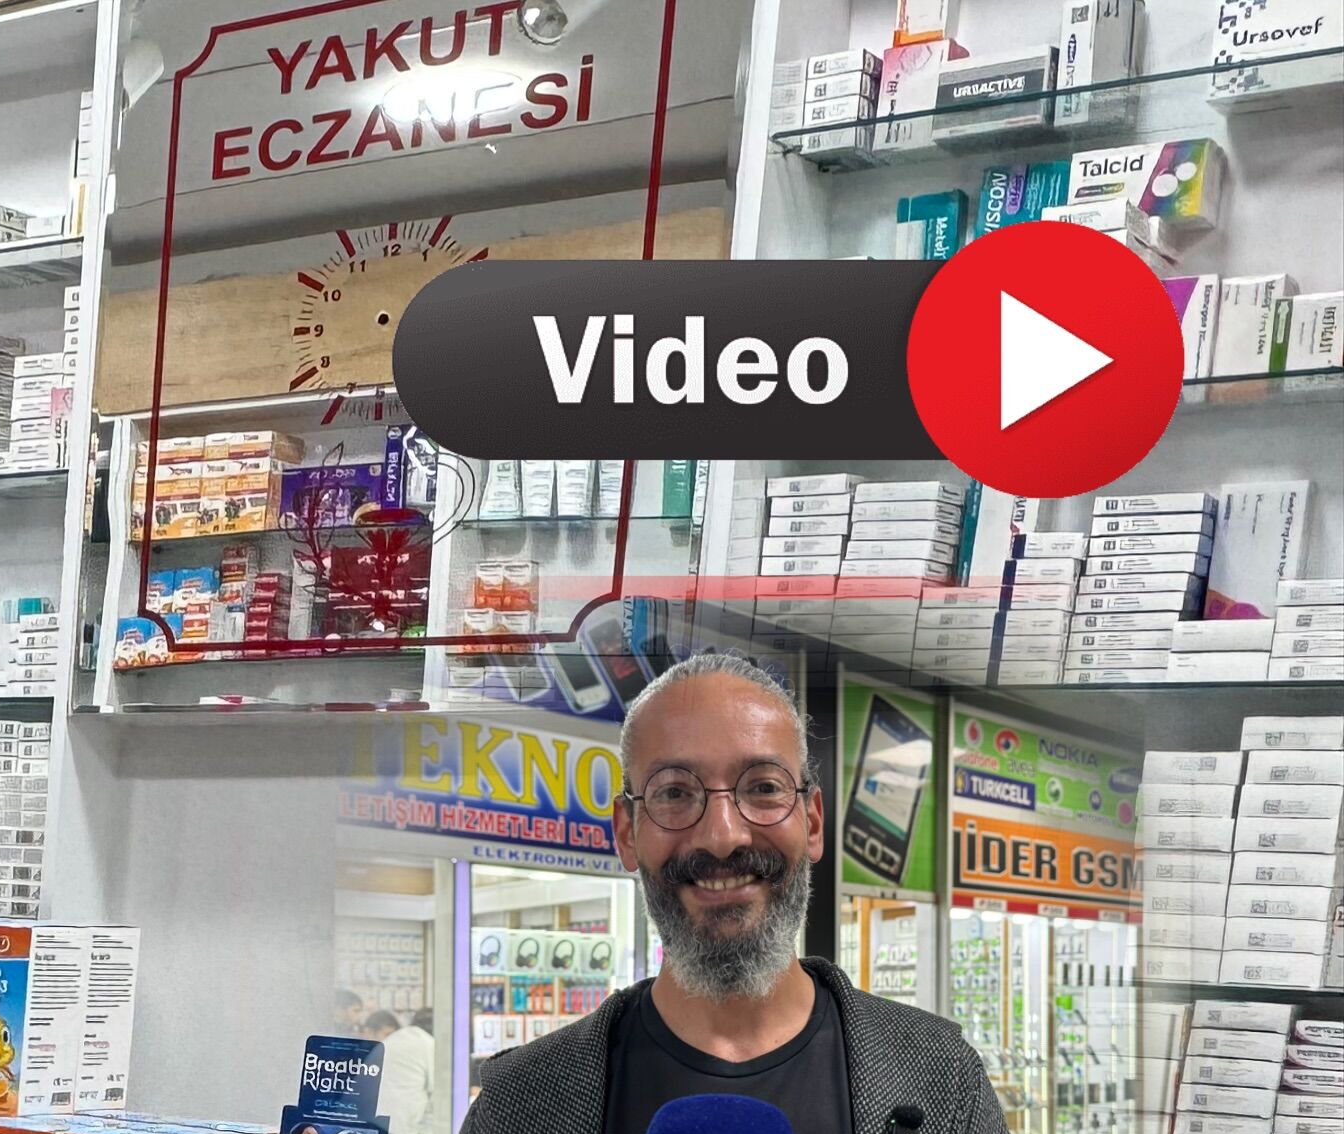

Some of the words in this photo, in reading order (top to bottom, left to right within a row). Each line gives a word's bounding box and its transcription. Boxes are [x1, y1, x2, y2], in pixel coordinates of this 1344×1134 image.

[268, 2, 520, 95] YAKUT
[1079, 155, 1145, 177] Talcid
[323, 289, 341, 302] 10
[314, 325, 324, 337] 9
[971, 776, 1031, 805] TURKCELL
[440, 801, 565, 842] HİZMETLERİ
[303, 1070, 358, 1093] Right
